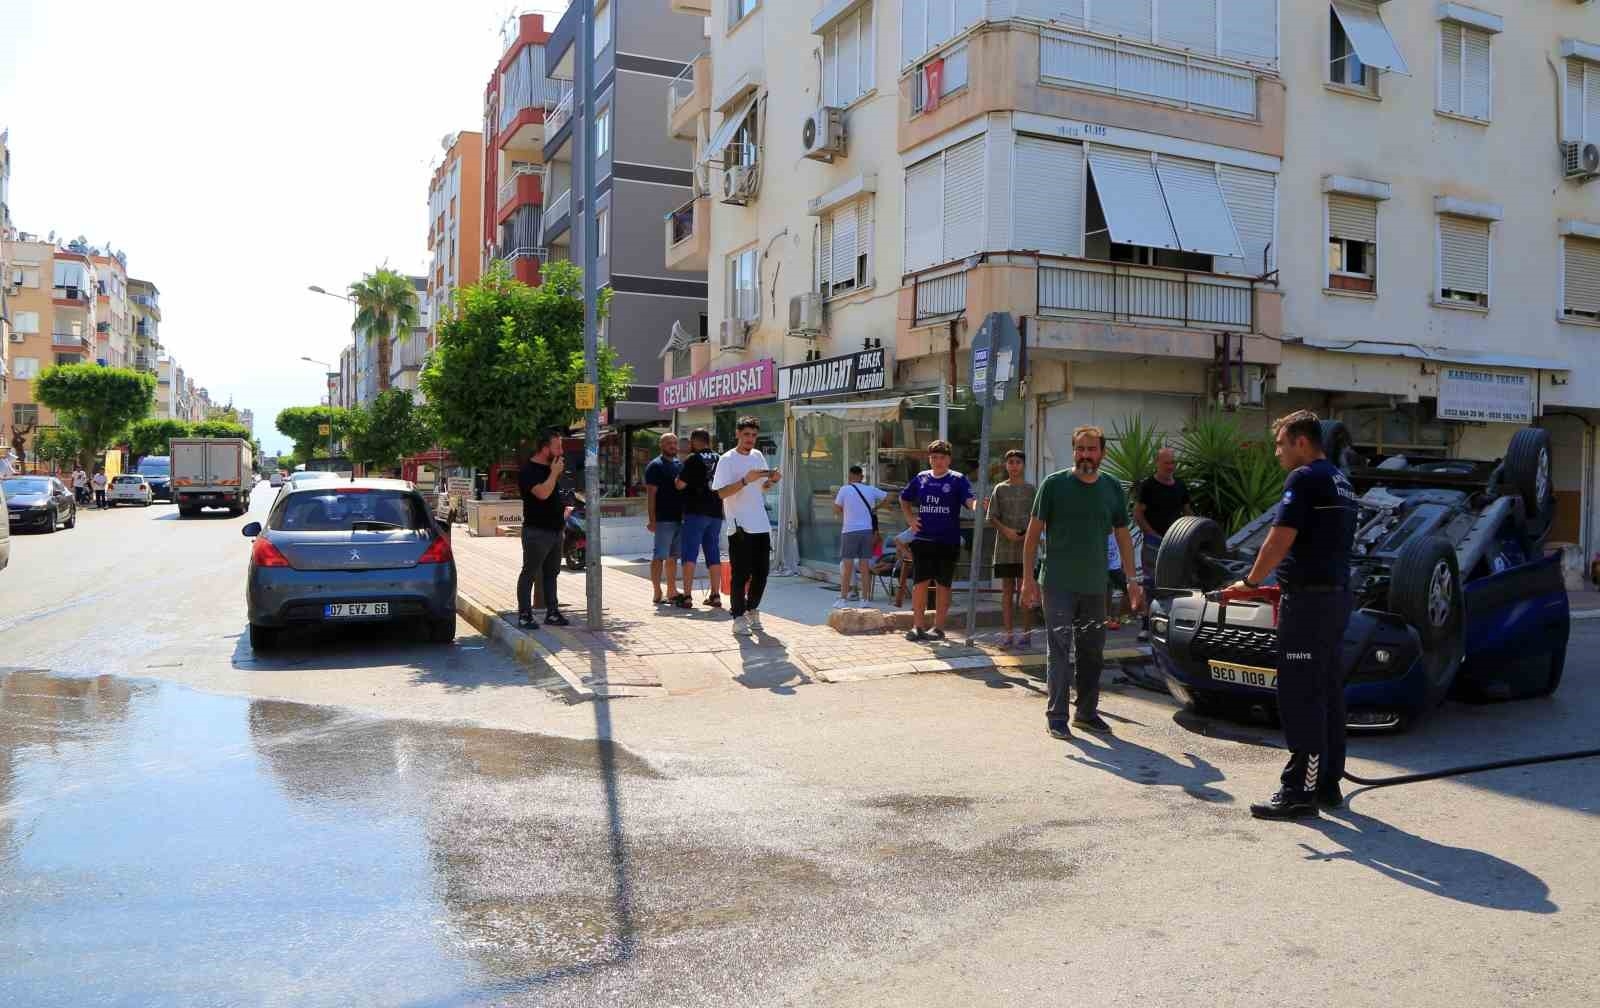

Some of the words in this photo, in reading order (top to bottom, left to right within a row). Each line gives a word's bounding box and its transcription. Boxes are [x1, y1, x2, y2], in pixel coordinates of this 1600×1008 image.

[858, 351, 881, 370] ERKEK
[699, 366, 764, 399] MEFRUŞAT
[790, 358, 853, 395] MOONLIGHT
[926, 495, 940, 504] Fly
[919, 504, 951, 514] Emirates
[499, 513, 522, 522] Kodak
[330, 604, 342, 616] 07
[374, 603, 387, 614] 66
[1212, 666, 1235, 681] 036
